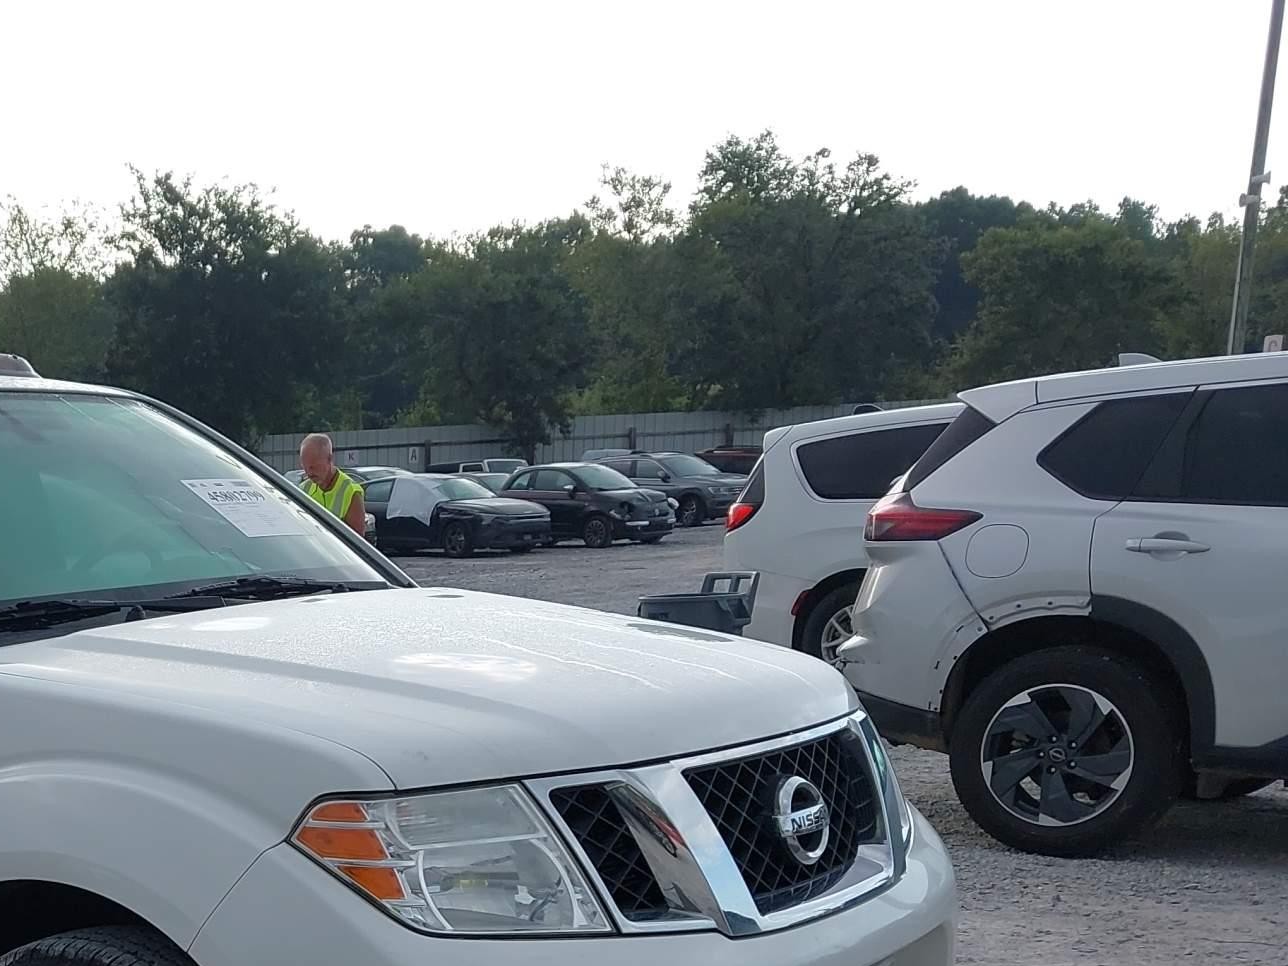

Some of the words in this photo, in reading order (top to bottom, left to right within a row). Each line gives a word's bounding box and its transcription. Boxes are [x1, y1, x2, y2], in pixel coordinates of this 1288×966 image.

[347, 452, 355, 461] K
[410, 447, 418, 461] A
[207, 490, 265, 504] 45802799
[790, 803, 826, 832] NISS
